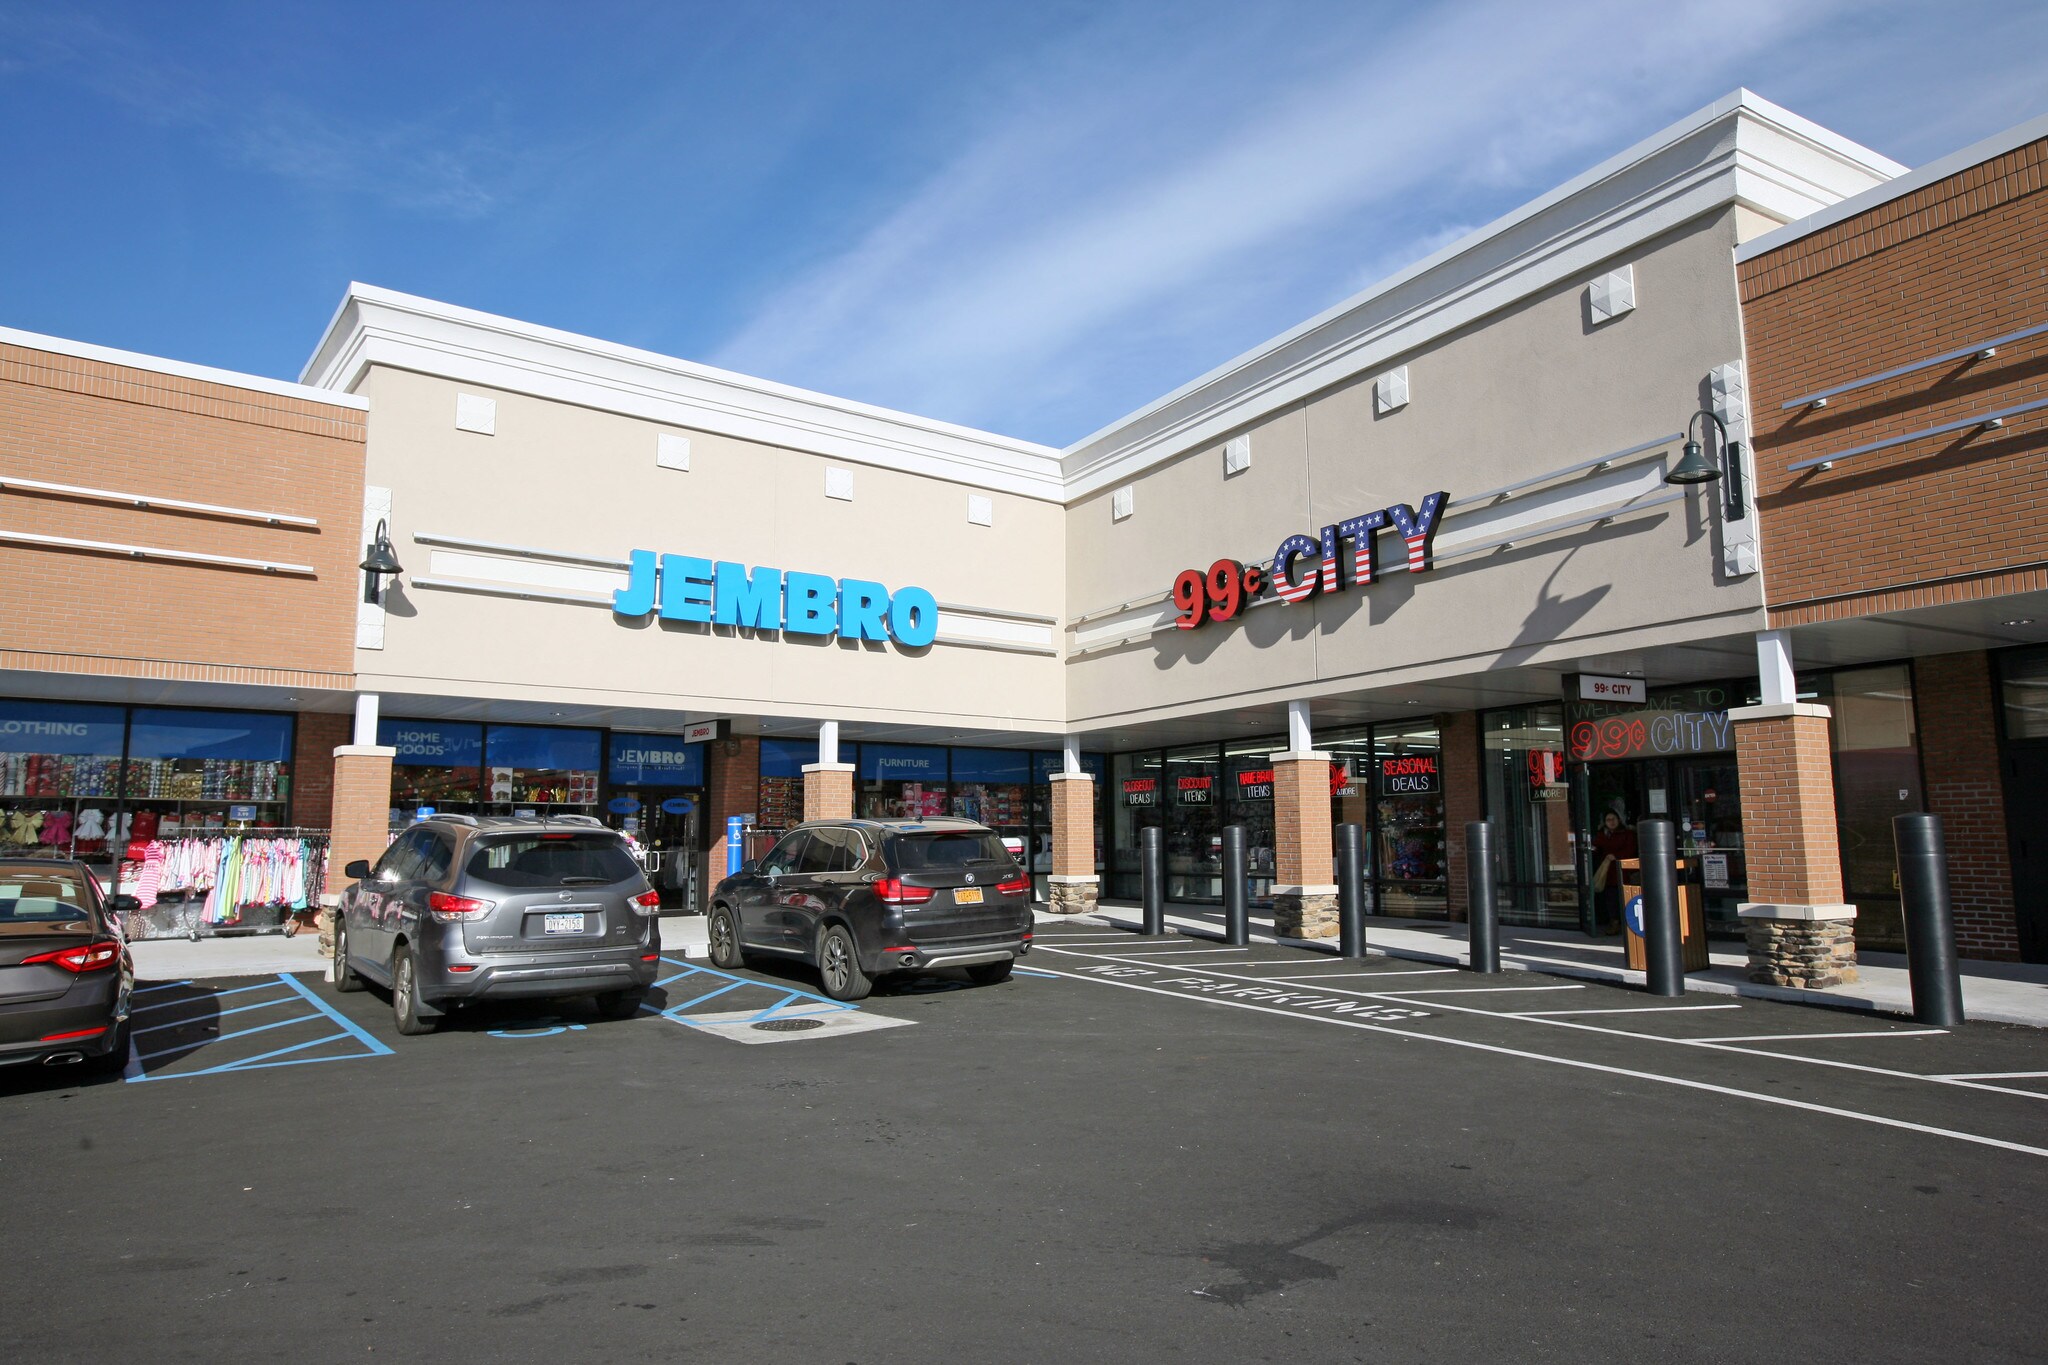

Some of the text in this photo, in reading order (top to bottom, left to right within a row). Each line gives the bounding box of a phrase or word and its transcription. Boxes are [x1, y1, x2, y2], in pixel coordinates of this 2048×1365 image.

[1272, 491, 1450, 603] CITY
[612, 549, 938, 646] JEMBRO
[1611, 684, 1632, 696] CITY
[1692, 689, 1725, 706] TO
[0, 721, 88, 736] OTHING
[692, 728, 710, 737] JEMBRO
[1651, 710, 1729, 753] CITY
[397, 731, 440, 742] HOME
[617, 750, 685, 765] JEMBRO
[879, 758, 930, 768] FURNITURE
[1042, 758, 1064, 768] SPEN
[1383, 757, 1437, 776] SEASONAL
[1178, 777, 1212, 789] DISCOUNT
[1239, 770, 1275, 785] NAME BRAN
[1392, 776, 1429, 791] DEALS
[1123, 780, 1156, 792] CLOSEOUT
[1247, 785, 1270, 798] ITEMS
[1129, 793, 1151, 804] DEALS
[1184, 791, 1207, 802] ITEMS
[1075, 964, 1431, 1020] NO PARKING
